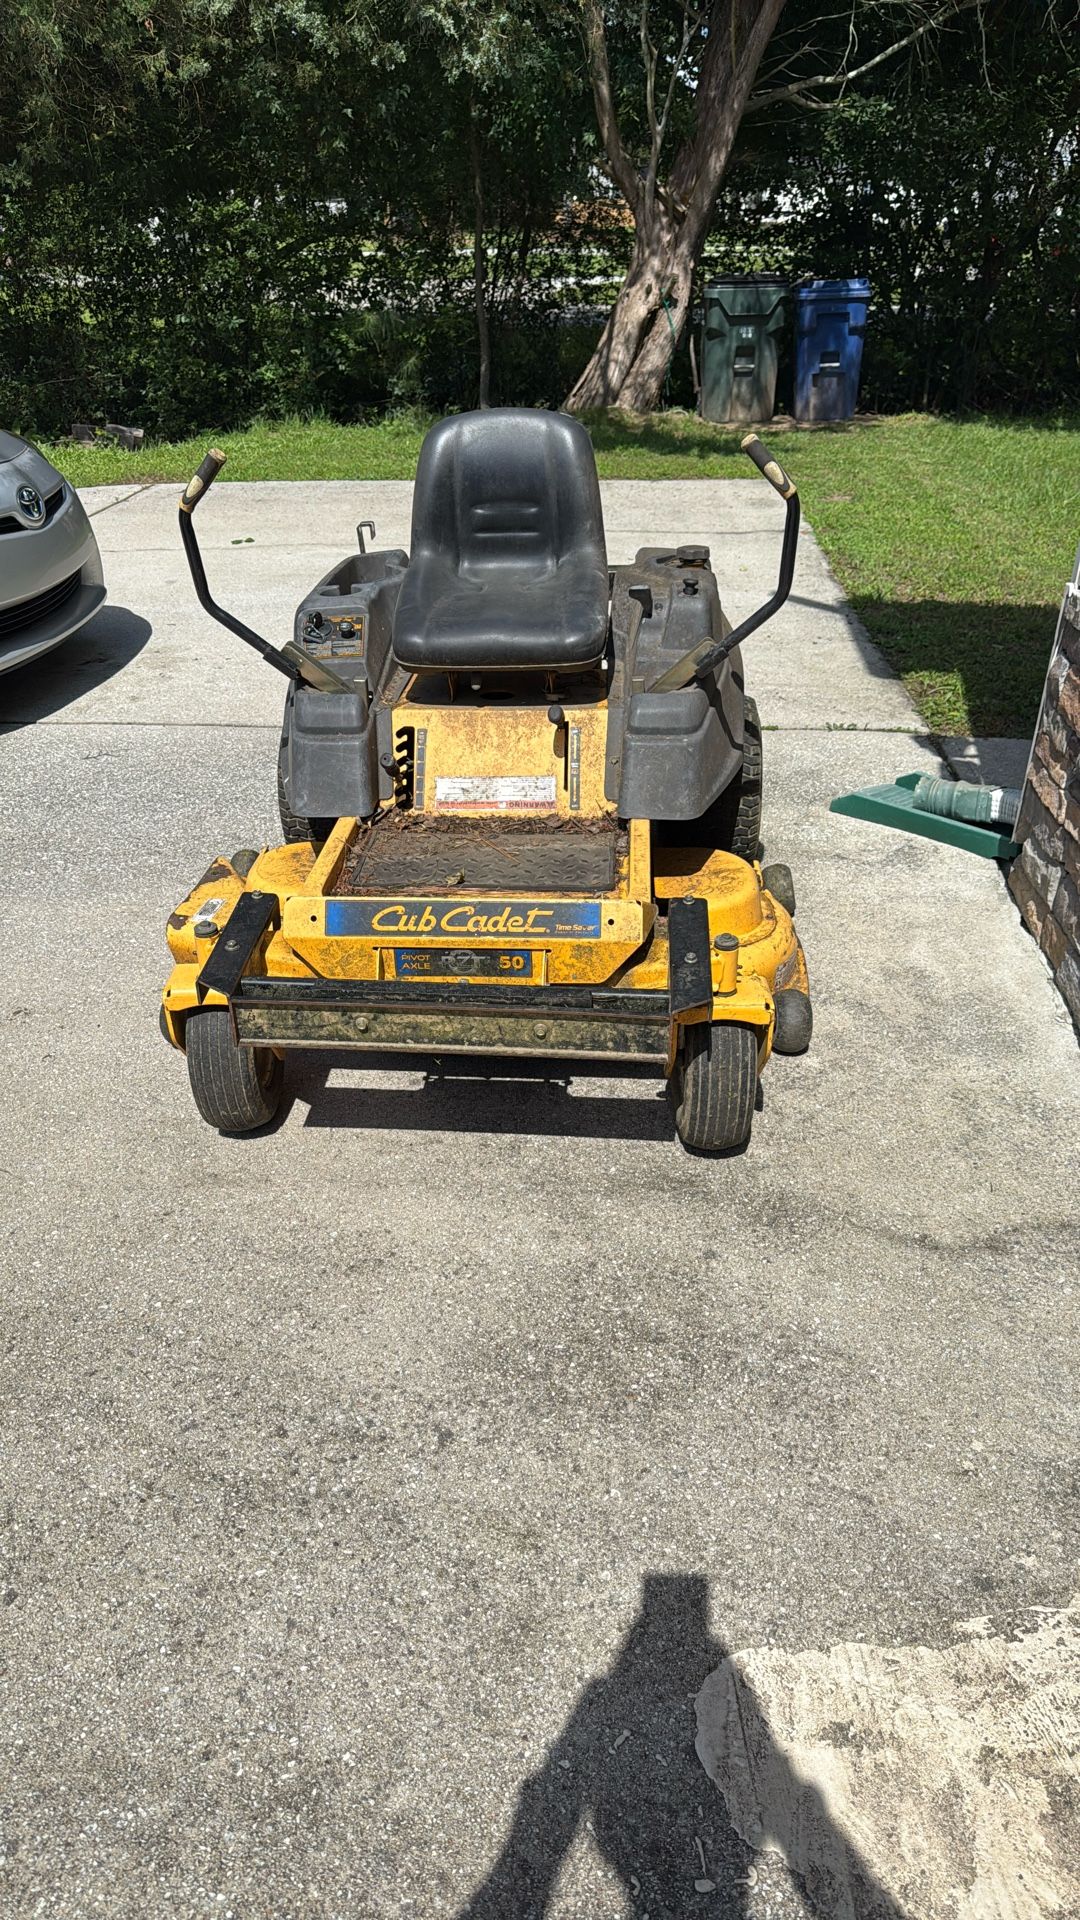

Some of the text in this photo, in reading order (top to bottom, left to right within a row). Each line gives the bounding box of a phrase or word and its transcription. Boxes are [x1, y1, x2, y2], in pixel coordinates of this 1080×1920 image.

[371, 905, 554, 933] Cub Cadet
[498, 955, 525, 970] 50
